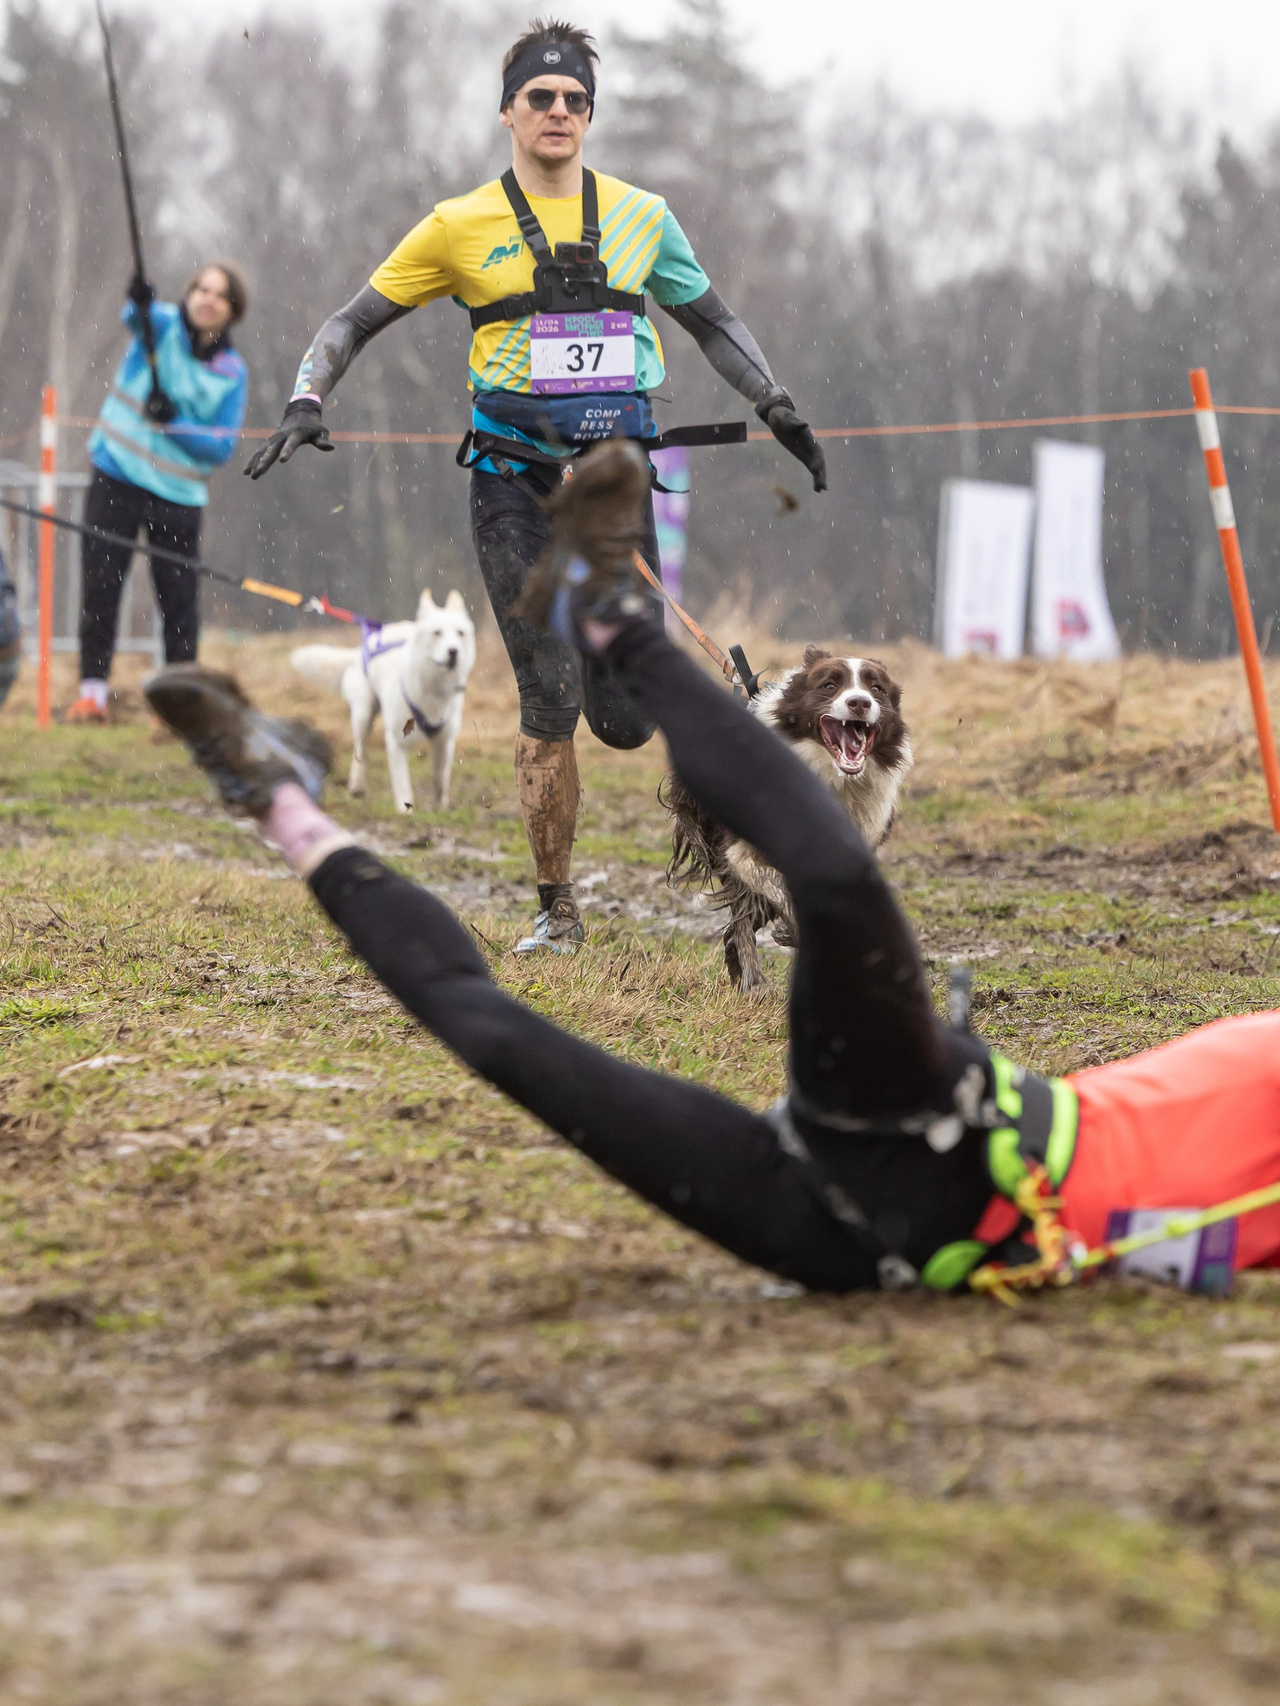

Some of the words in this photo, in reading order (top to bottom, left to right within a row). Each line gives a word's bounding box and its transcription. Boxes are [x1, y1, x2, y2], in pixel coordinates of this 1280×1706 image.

[566, 343, 604, 372] 37
[585, 409, 621, 419] COMP
[579, 420, 614, 431] RESS
